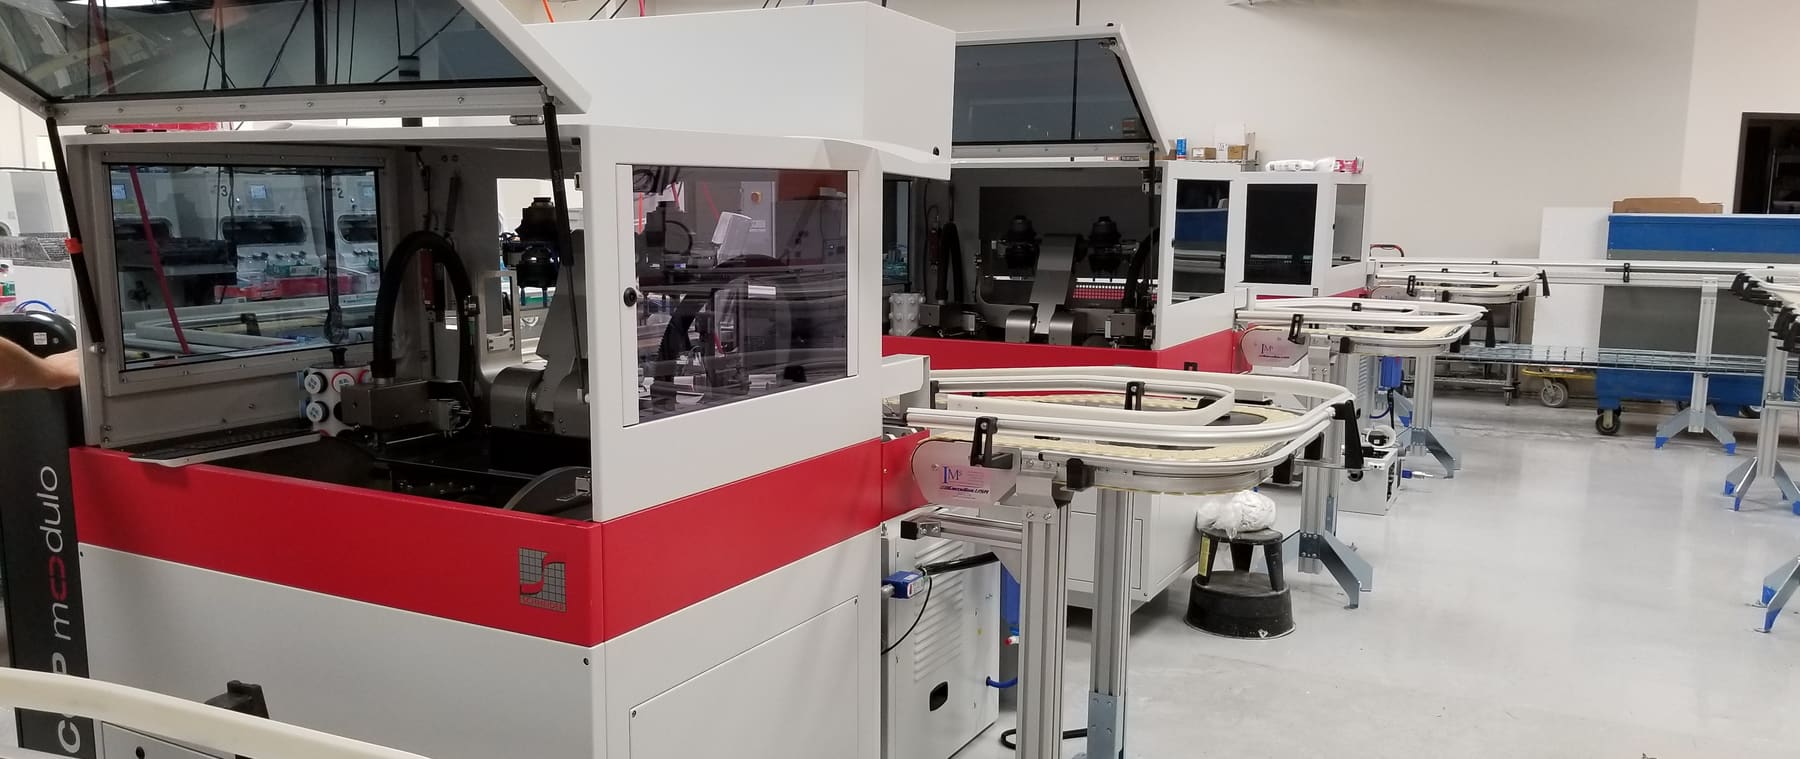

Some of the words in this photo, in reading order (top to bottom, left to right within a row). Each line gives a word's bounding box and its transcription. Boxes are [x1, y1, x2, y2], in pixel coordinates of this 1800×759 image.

[220, 185, 228, 197] 3
[337, 187, 345, 198] 2
[53, 652, 81, 753] CP
